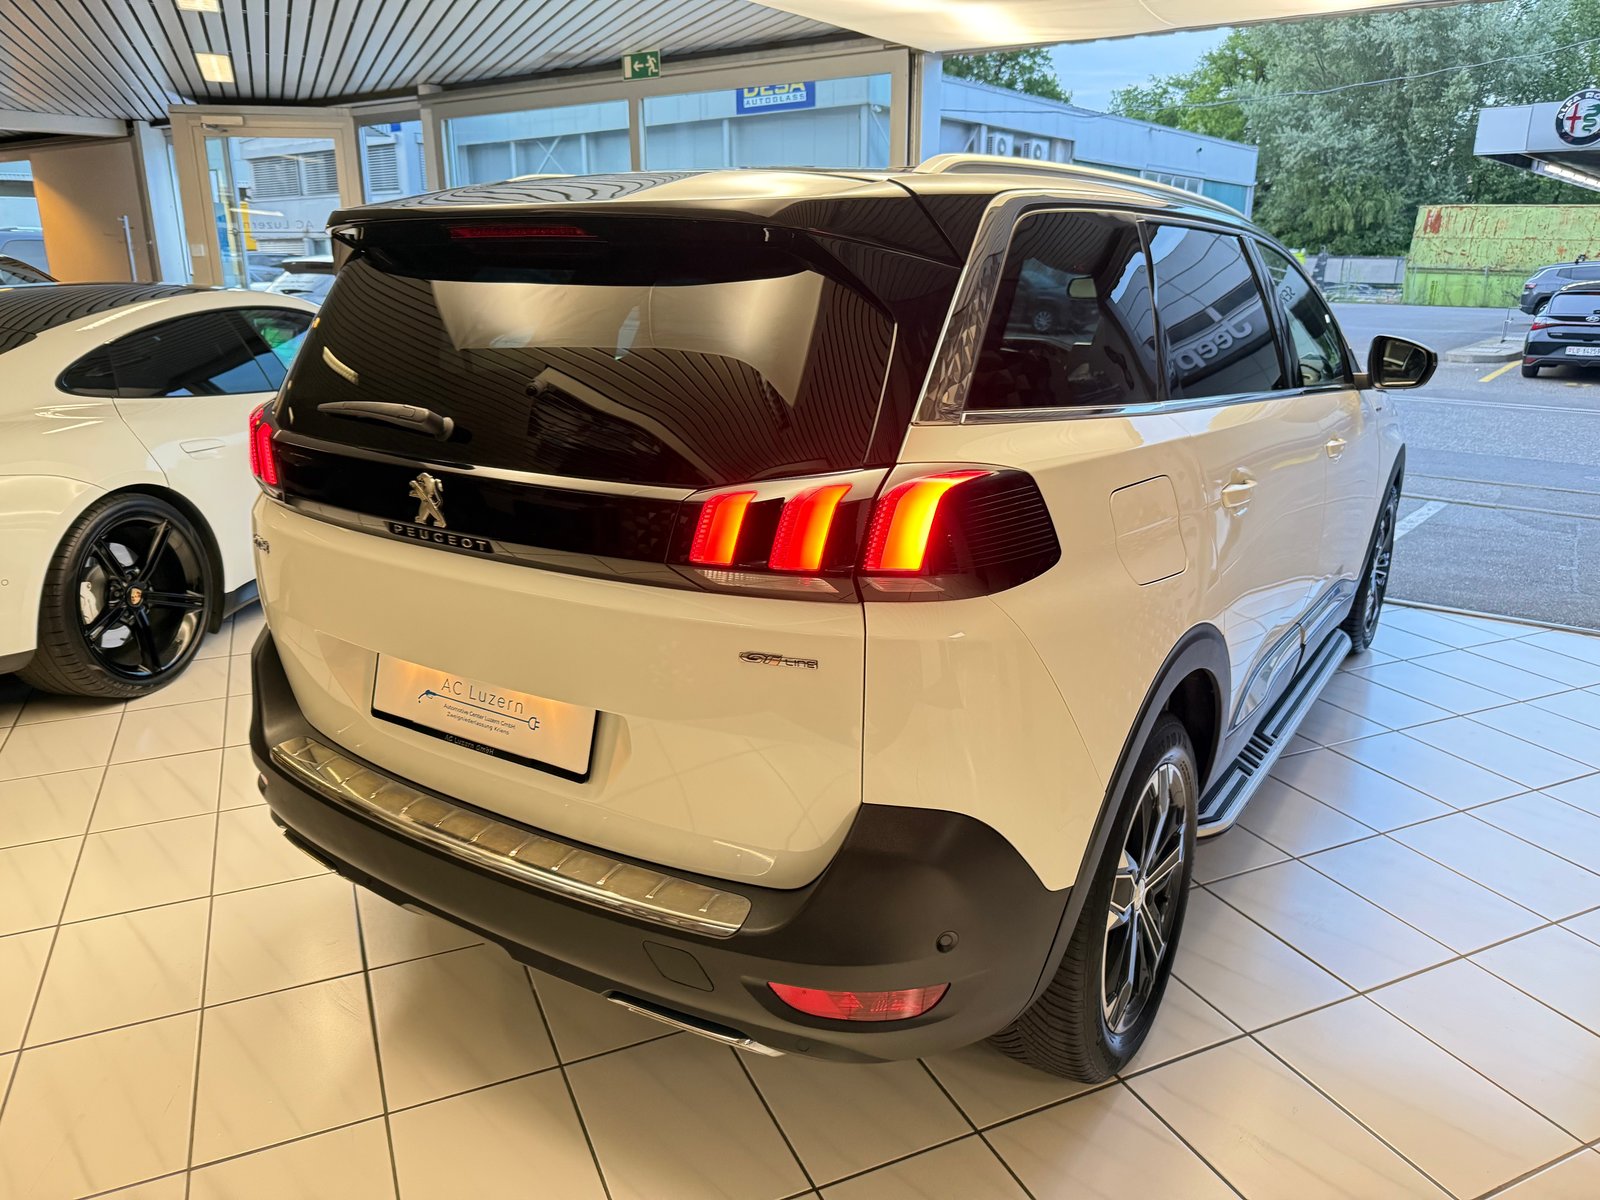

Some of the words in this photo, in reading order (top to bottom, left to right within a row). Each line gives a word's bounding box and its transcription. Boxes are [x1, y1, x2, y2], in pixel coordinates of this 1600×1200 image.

[745, 93, 806, 106] AUTOGLASS
[1557, 96, 1582, 120] ALFA
[393, 524, 487, 551] PEUGEOT
[441, 678, 463, 696] AC
[469, 685, 524, 714] Luzern
[443, 703, 469, 716] Automotive
[484, 715, 500, 725] Luzern
[500, 721, 516, 730] GmbH
[444, 734, 453, 742] AC
[475, 744, 495, 755] GmbH
